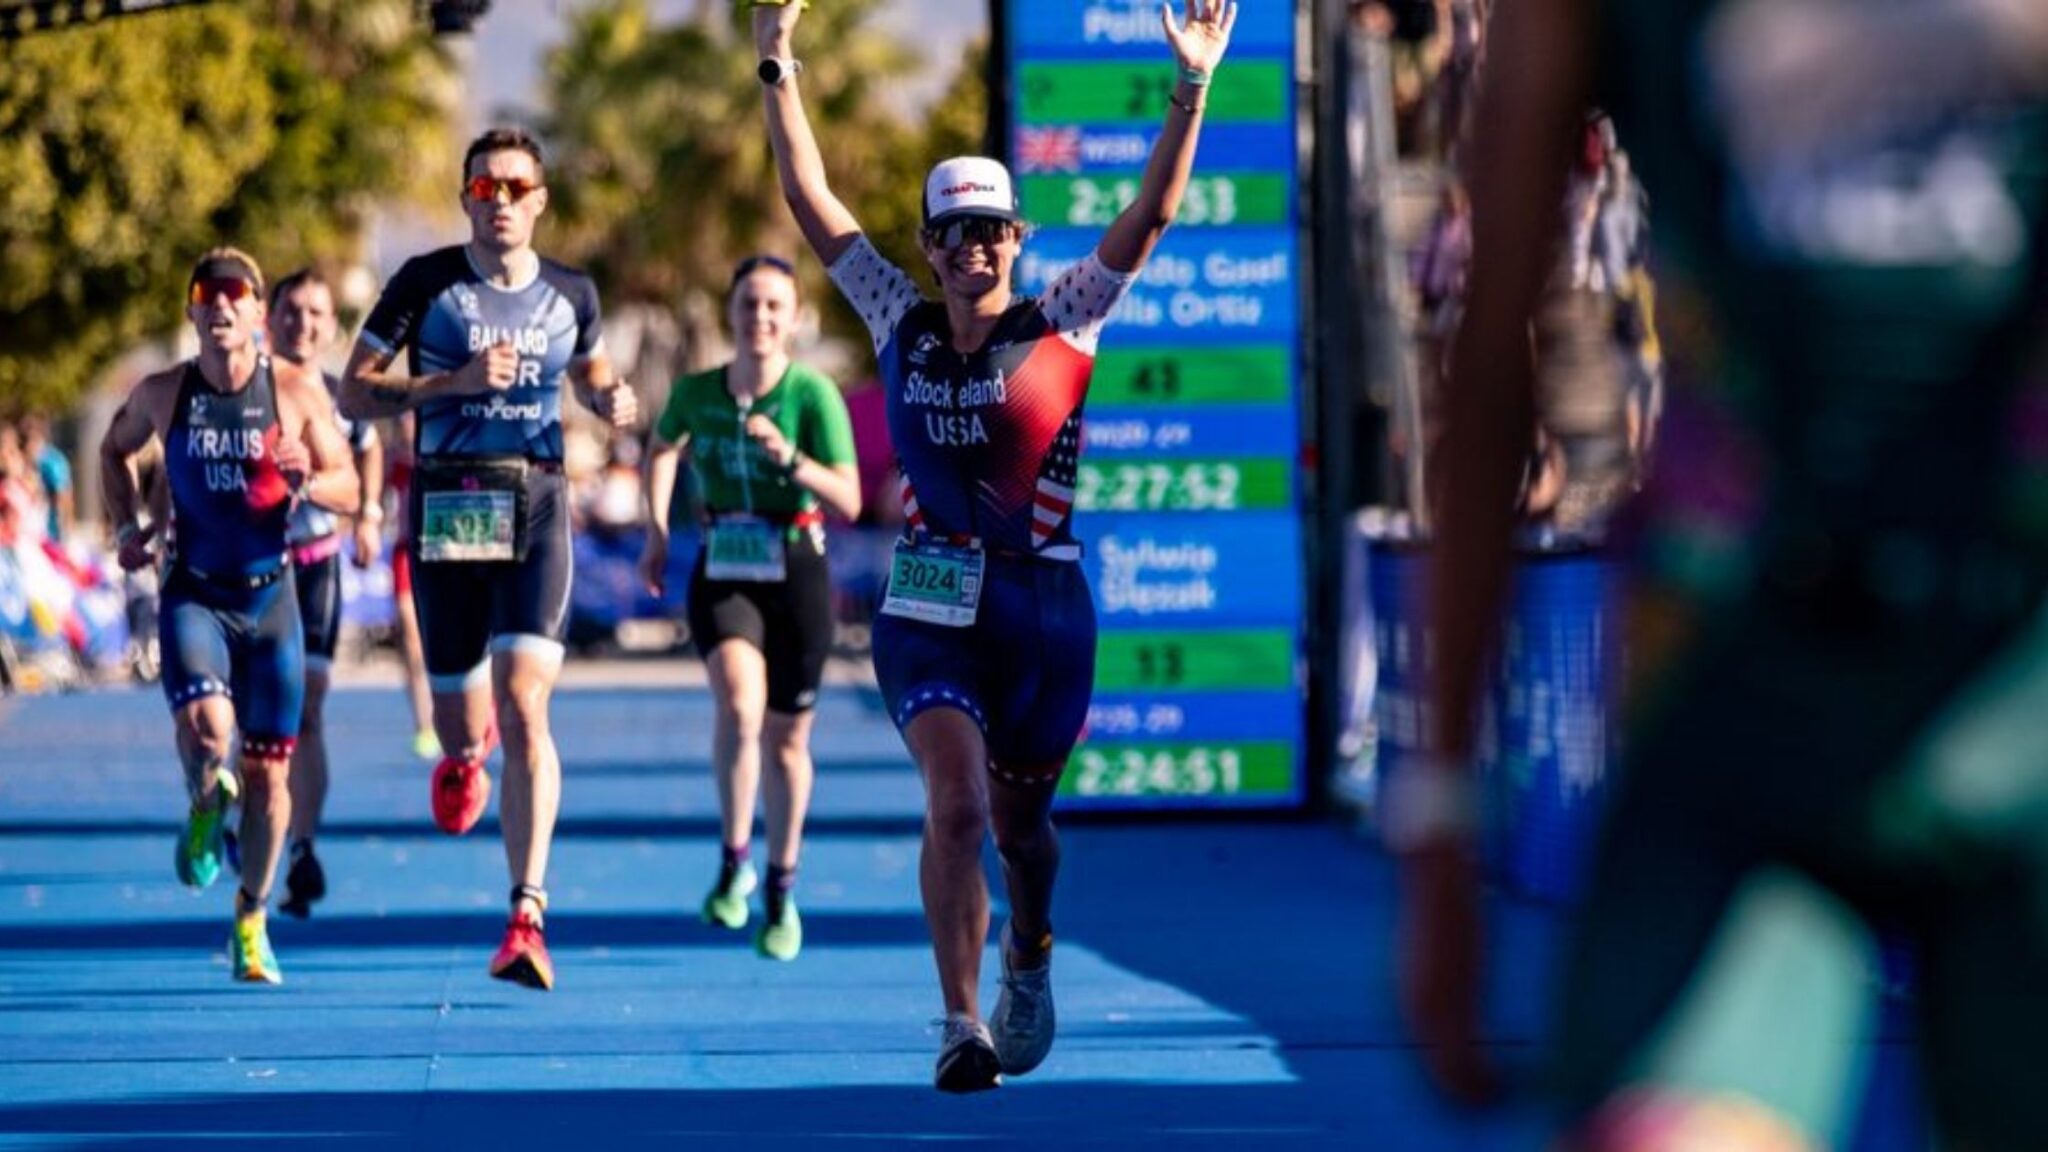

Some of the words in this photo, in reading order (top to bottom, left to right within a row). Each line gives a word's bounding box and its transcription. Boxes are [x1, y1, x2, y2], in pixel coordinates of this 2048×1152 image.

[187, 428, 264, 460] KRAUS
[926, 413, 990, 446] USA
[205, 463, 249, 492] USA
[897, 560, 955, 592] 3024
[1076, 748, 1240, 796] 2:24:51
